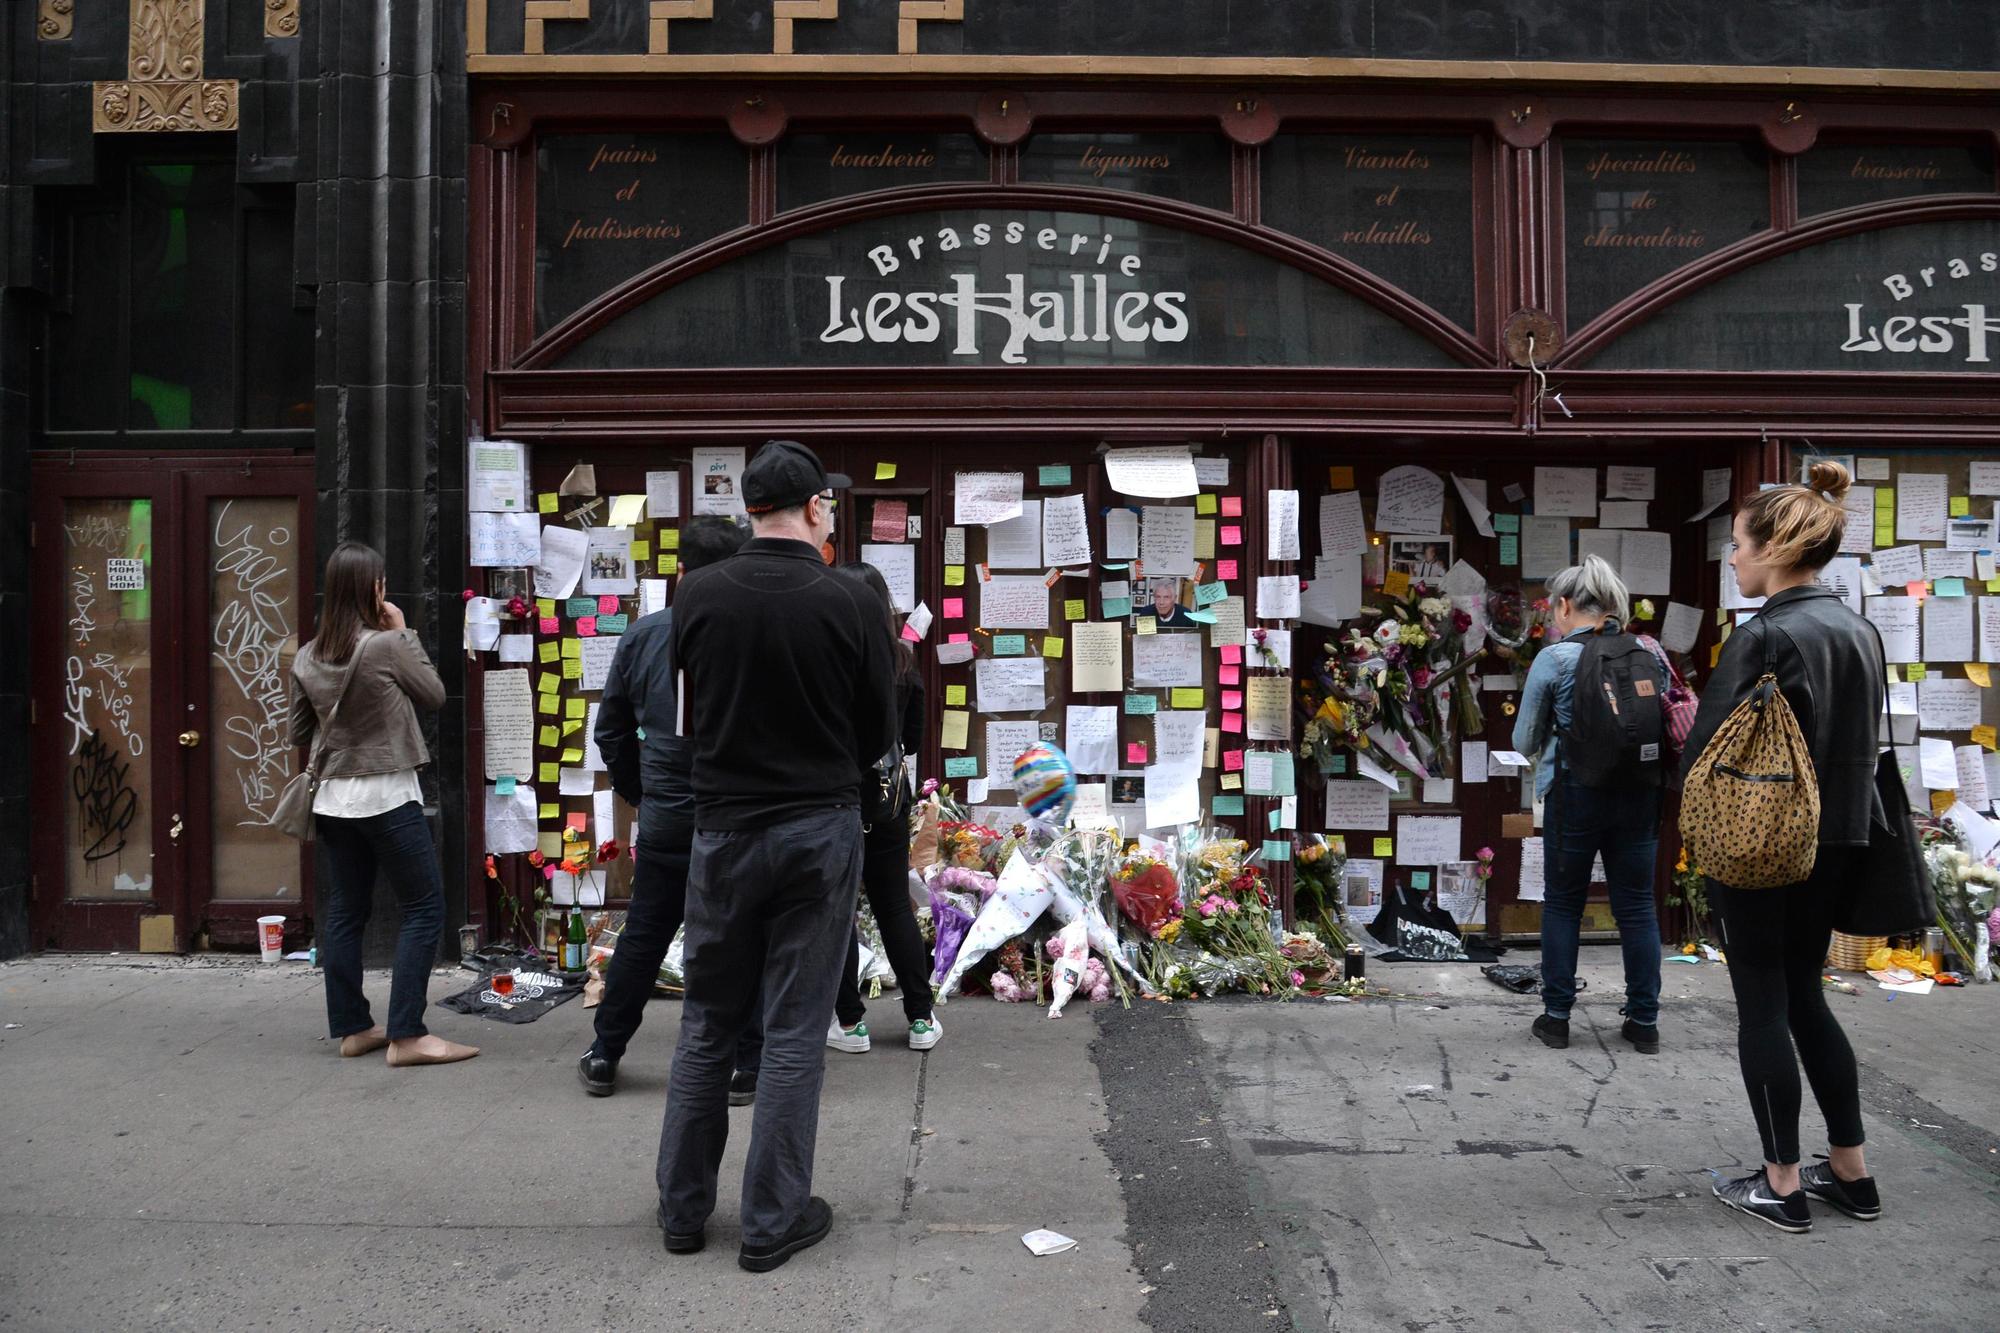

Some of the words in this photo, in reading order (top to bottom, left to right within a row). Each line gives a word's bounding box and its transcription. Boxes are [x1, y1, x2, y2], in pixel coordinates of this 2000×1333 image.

[588, 143, 657, 172] pains
[830, 143, 937, 168] boucherie
[1344, 145, 1431, 169] Viandes
[1850, 156, 1942, 180] brasserie
[1583, 224, 1705, 248] charcuterie
[867, 221, 1142, 277] Brasserie
[819, 275, 940, 343] Les
[938, 273, 1190, 364] Halles
[1840, 303, 1954, 353] Les
[109, 559, 134, 567] CALL
